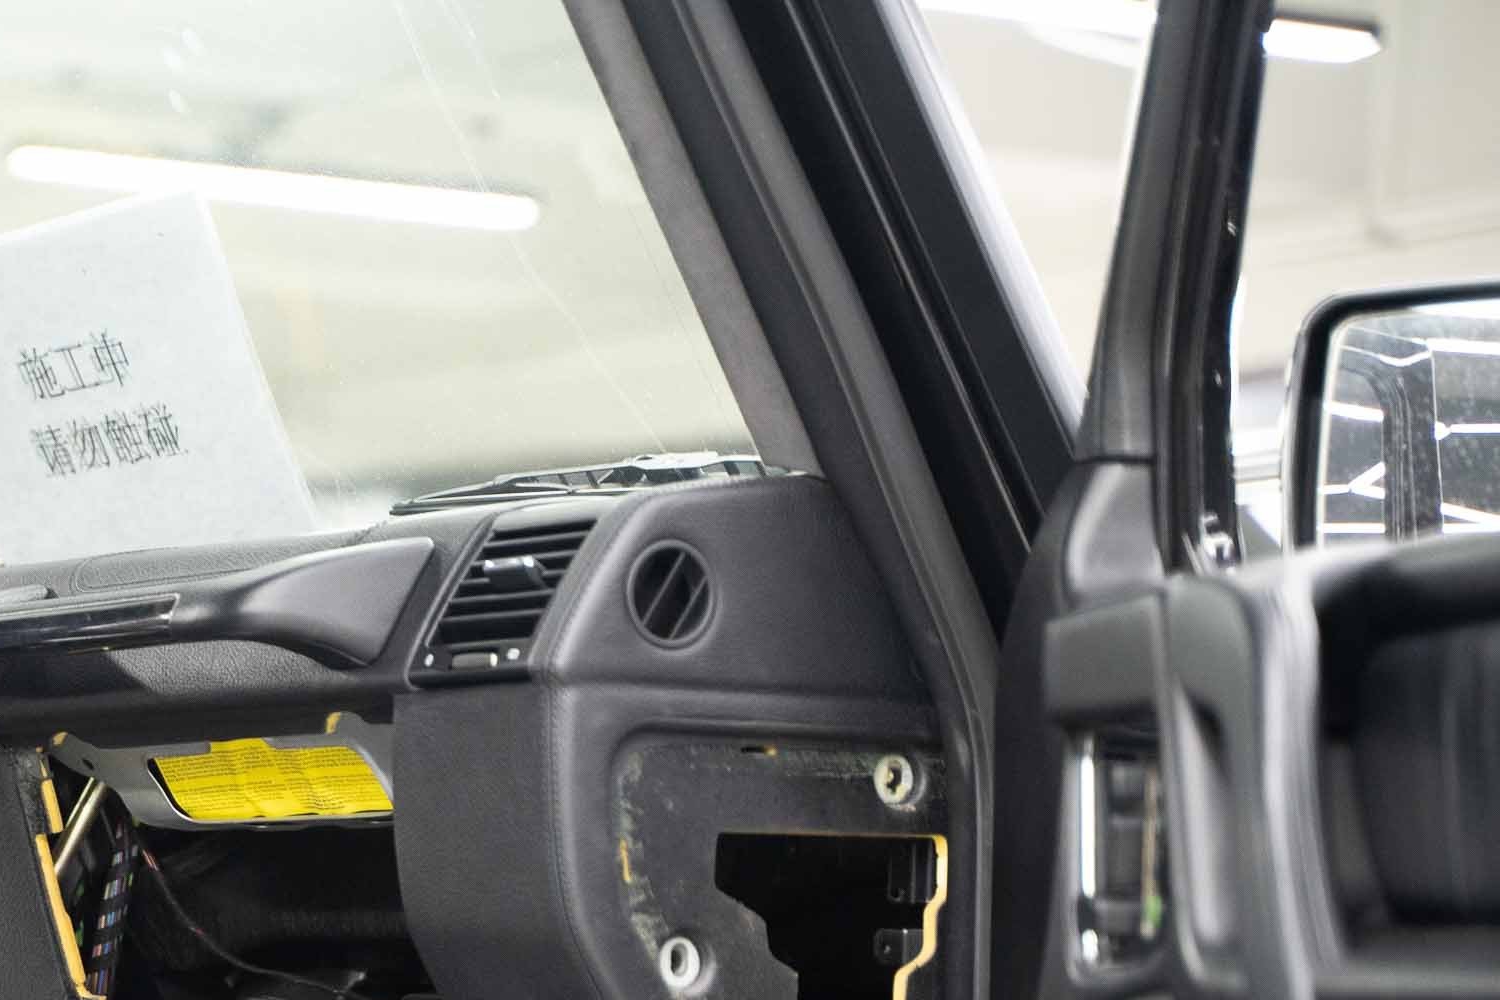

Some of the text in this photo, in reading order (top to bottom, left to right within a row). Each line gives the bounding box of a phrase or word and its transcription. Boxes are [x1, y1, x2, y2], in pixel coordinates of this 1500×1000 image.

[17, 329, 131, 400] 施工中
[31, 401, 183, 478] 请勿触碰
